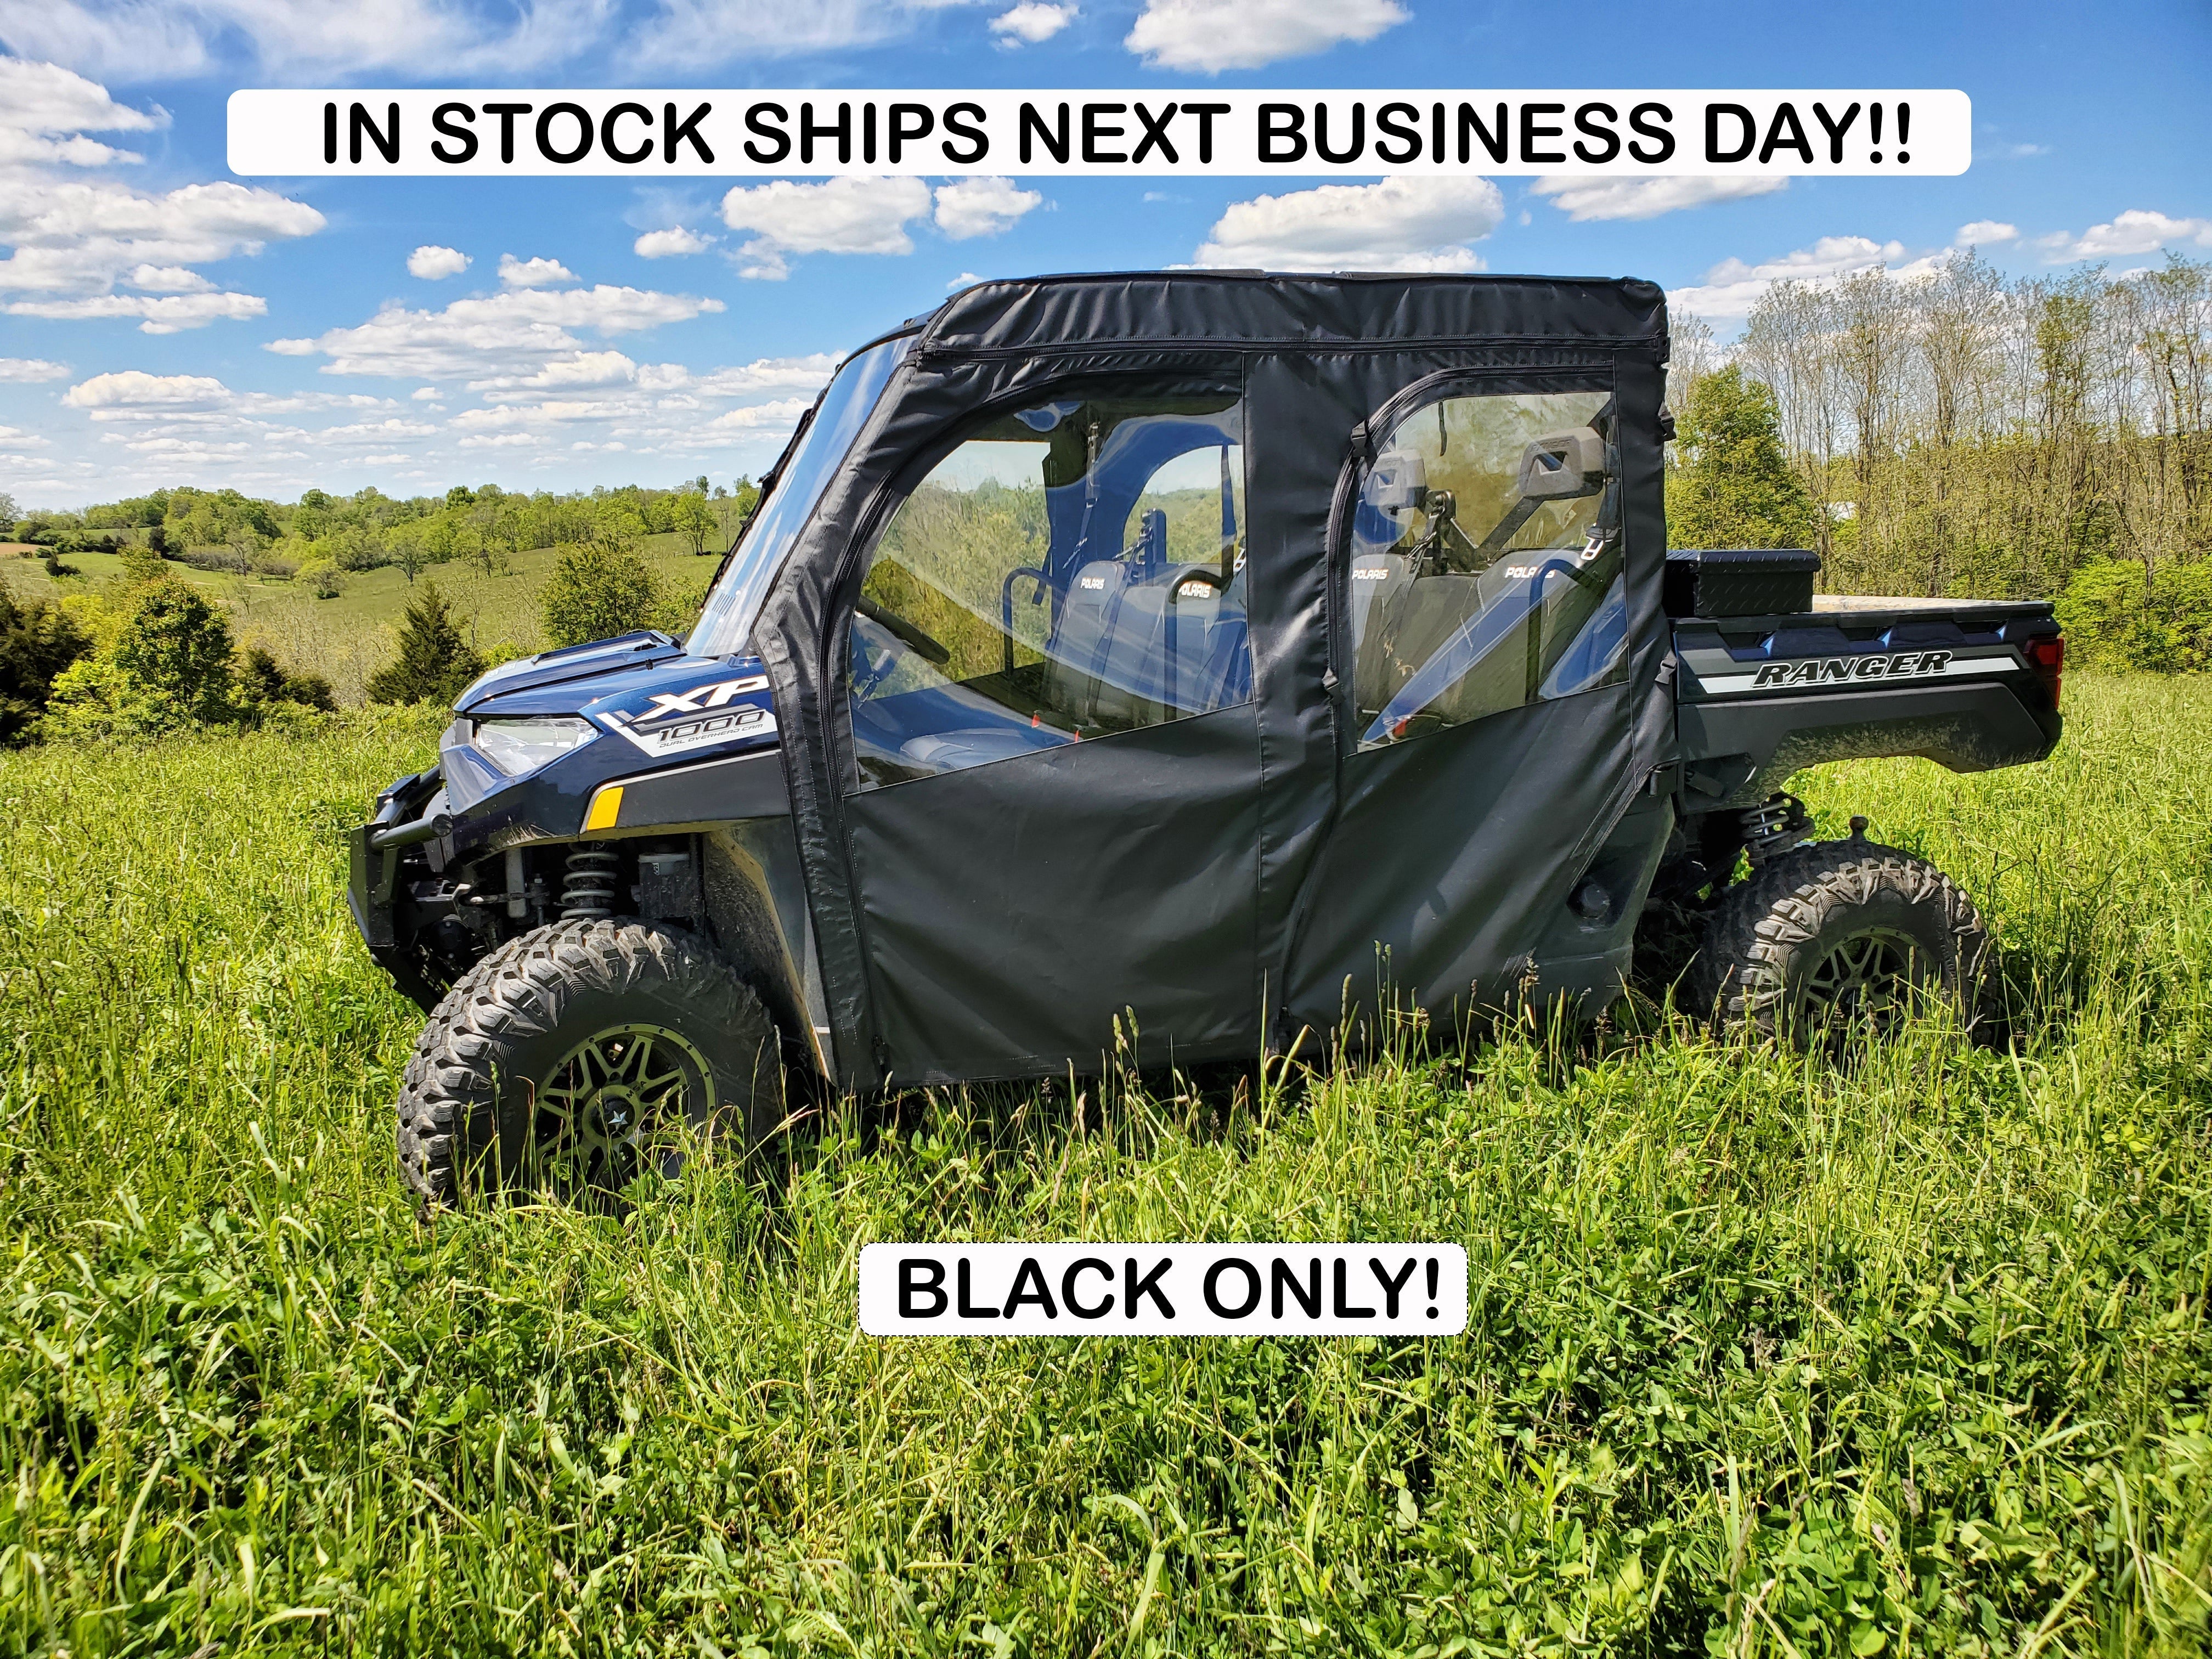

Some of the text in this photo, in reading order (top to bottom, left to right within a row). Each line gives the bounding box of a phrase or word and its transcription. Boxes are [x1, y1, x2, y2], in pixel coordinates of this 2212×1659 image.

[1351, 568, 1389, 580] POLARIS
[1504, 566, 1556, 578] POLAS
[1080, 578, 1105, 590] POLARIS
[1751, 650, 1953, 688] RANGER
[625, 675, 769, 725] XP
[658, 710, 766, 742] 1000
[659, 740, 686, 748] DUAL
[688, 728, 740, 742] OVERHEAD
